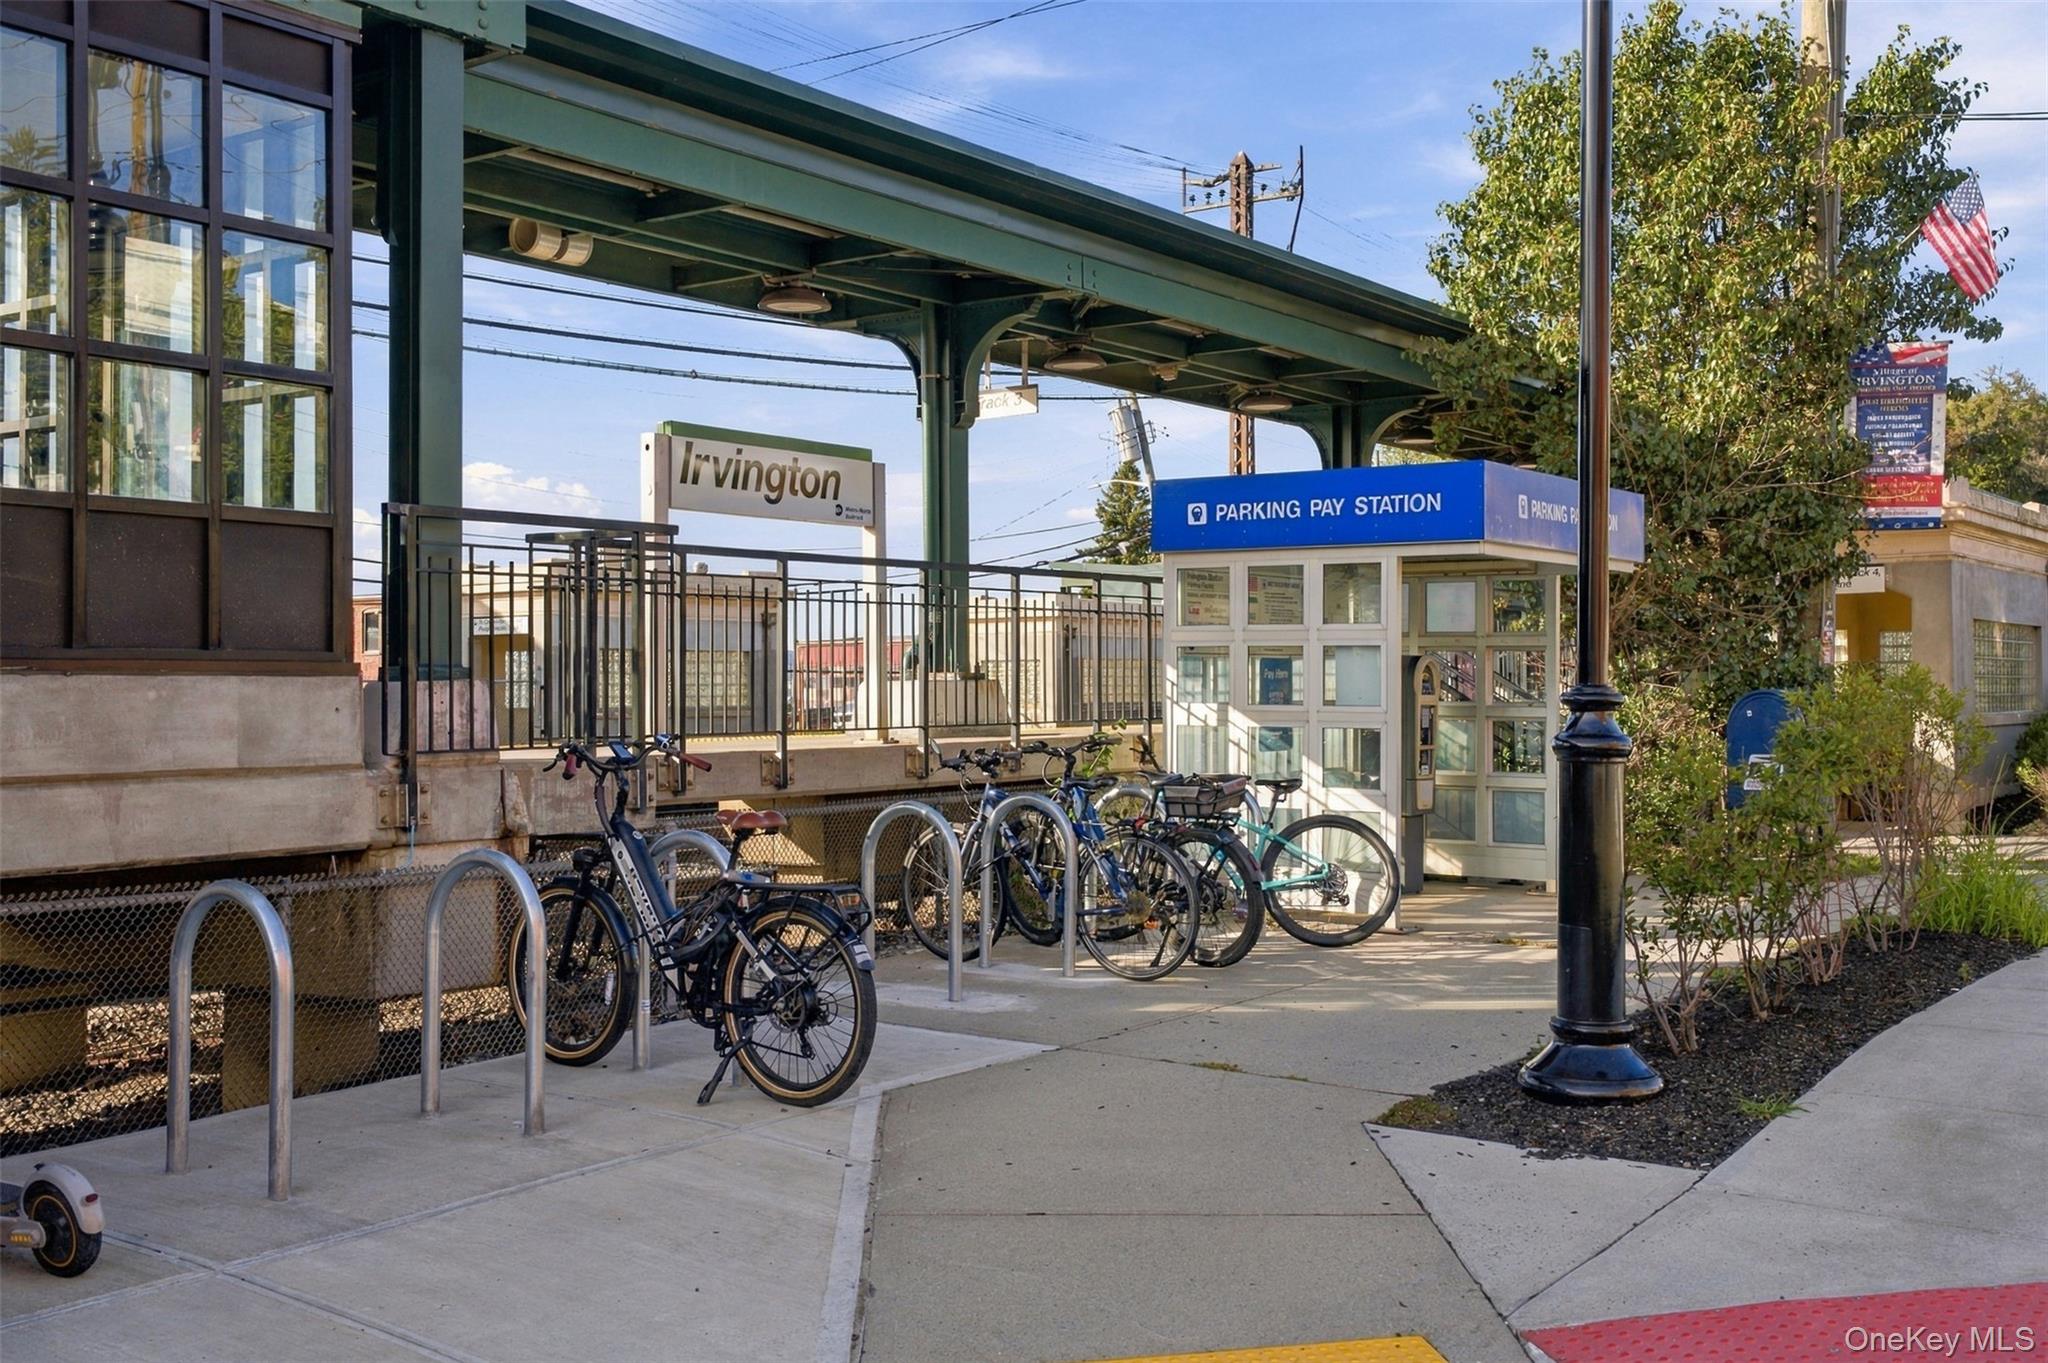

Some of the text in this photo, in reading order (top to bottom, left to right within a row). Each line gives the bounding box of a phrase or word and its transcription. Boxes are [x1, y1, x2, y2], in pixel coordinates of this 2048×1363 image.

[979, 392, 1023, 409] rack 3
[680, 441, 842, 505] Irvington
[1216, 493, 1441, 522] PARKING PAY STATION
[1531, 500, 1568, 523] PARKING
